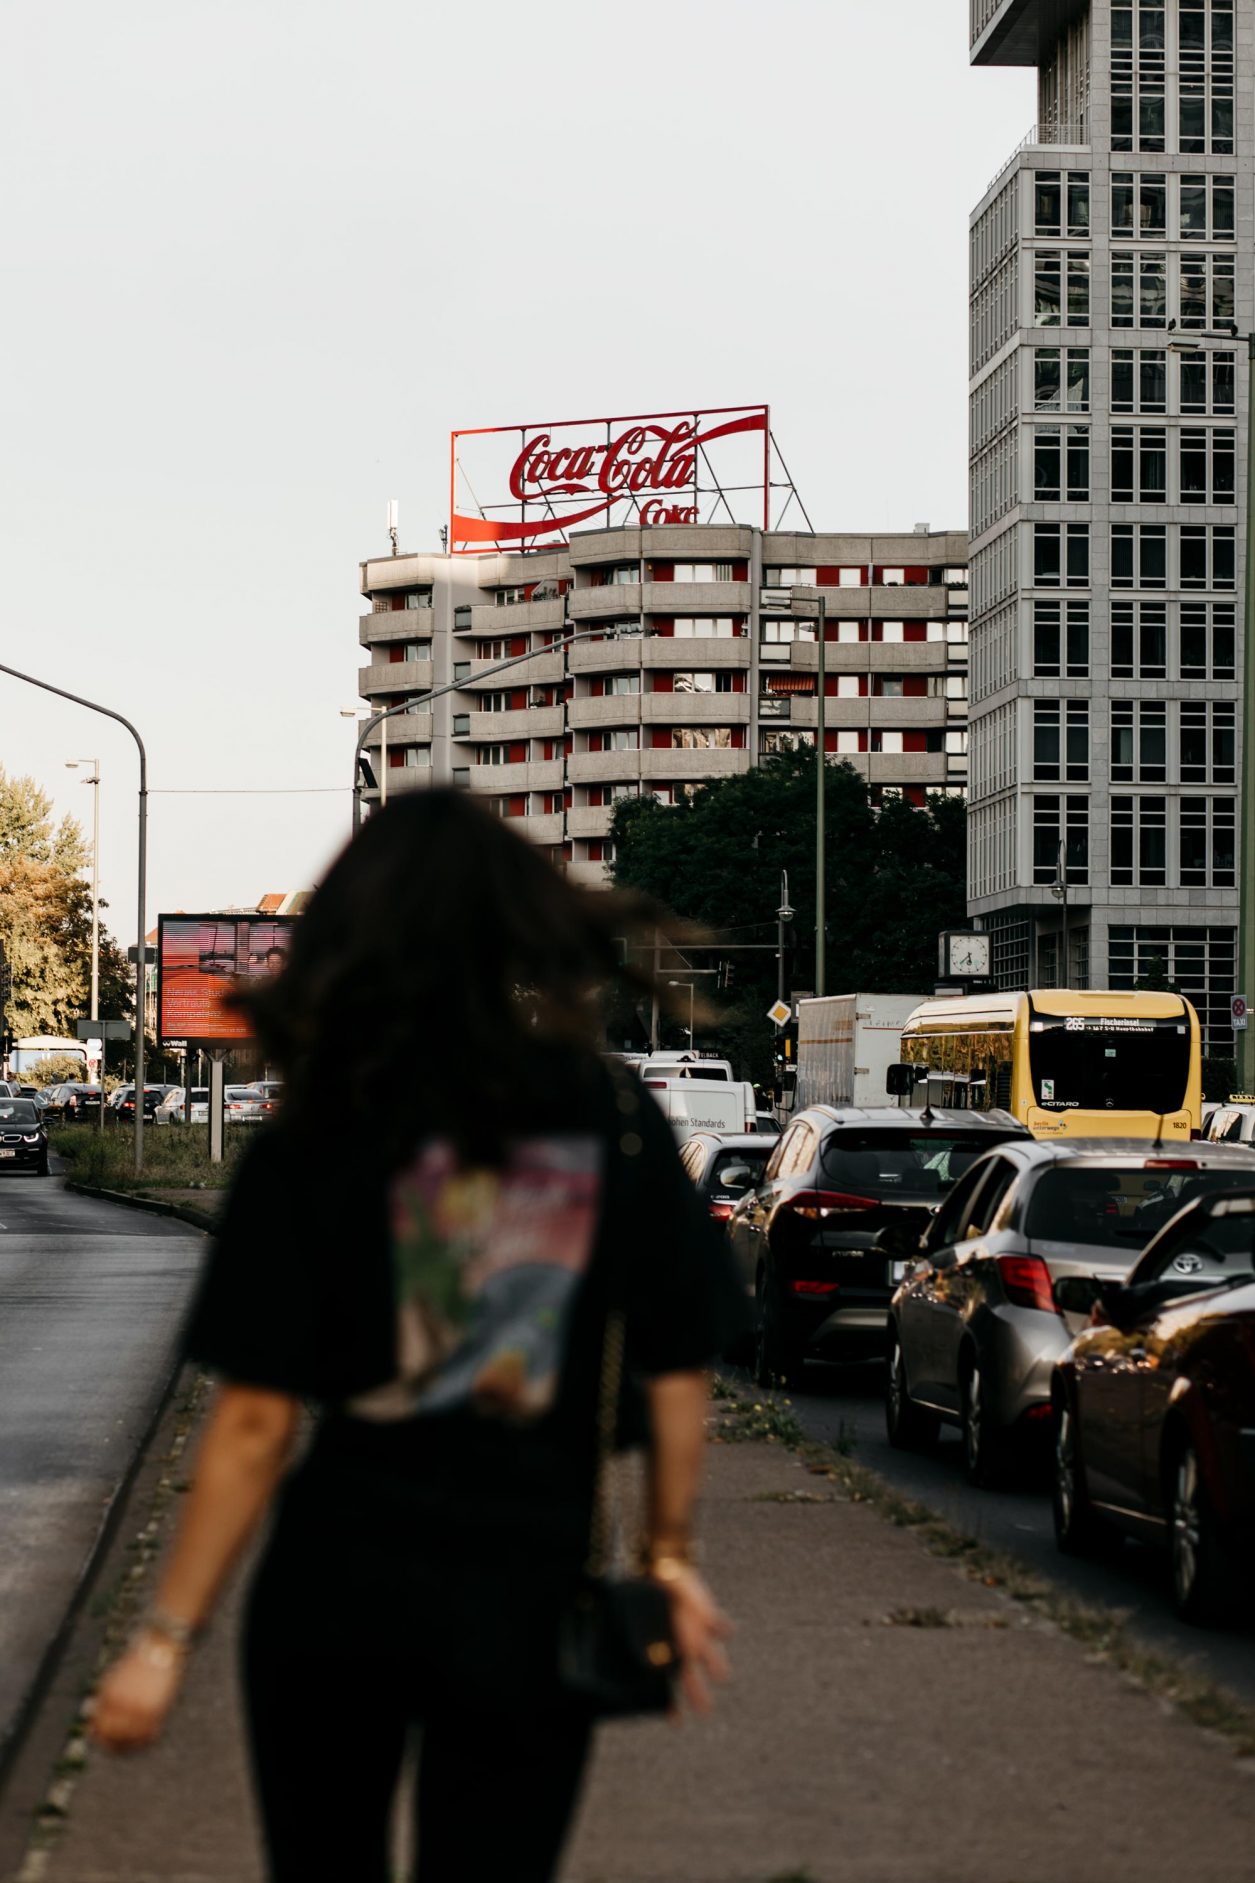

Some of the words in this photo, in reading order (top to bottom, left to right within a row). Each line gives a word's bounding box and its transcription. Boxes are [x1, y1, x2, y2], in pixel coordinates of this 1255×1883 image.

[509, 420, 701, 501] Coca-Cola
[639, 498, 699, 525] Coke
[1065, 1016, 1085, 1031] 265
[1100, 1017, 1139, 1026] Fischerinsel
[1233, 1018, 1246, 1026] TAXI
[690, 1117, 726, 1129] Standards
